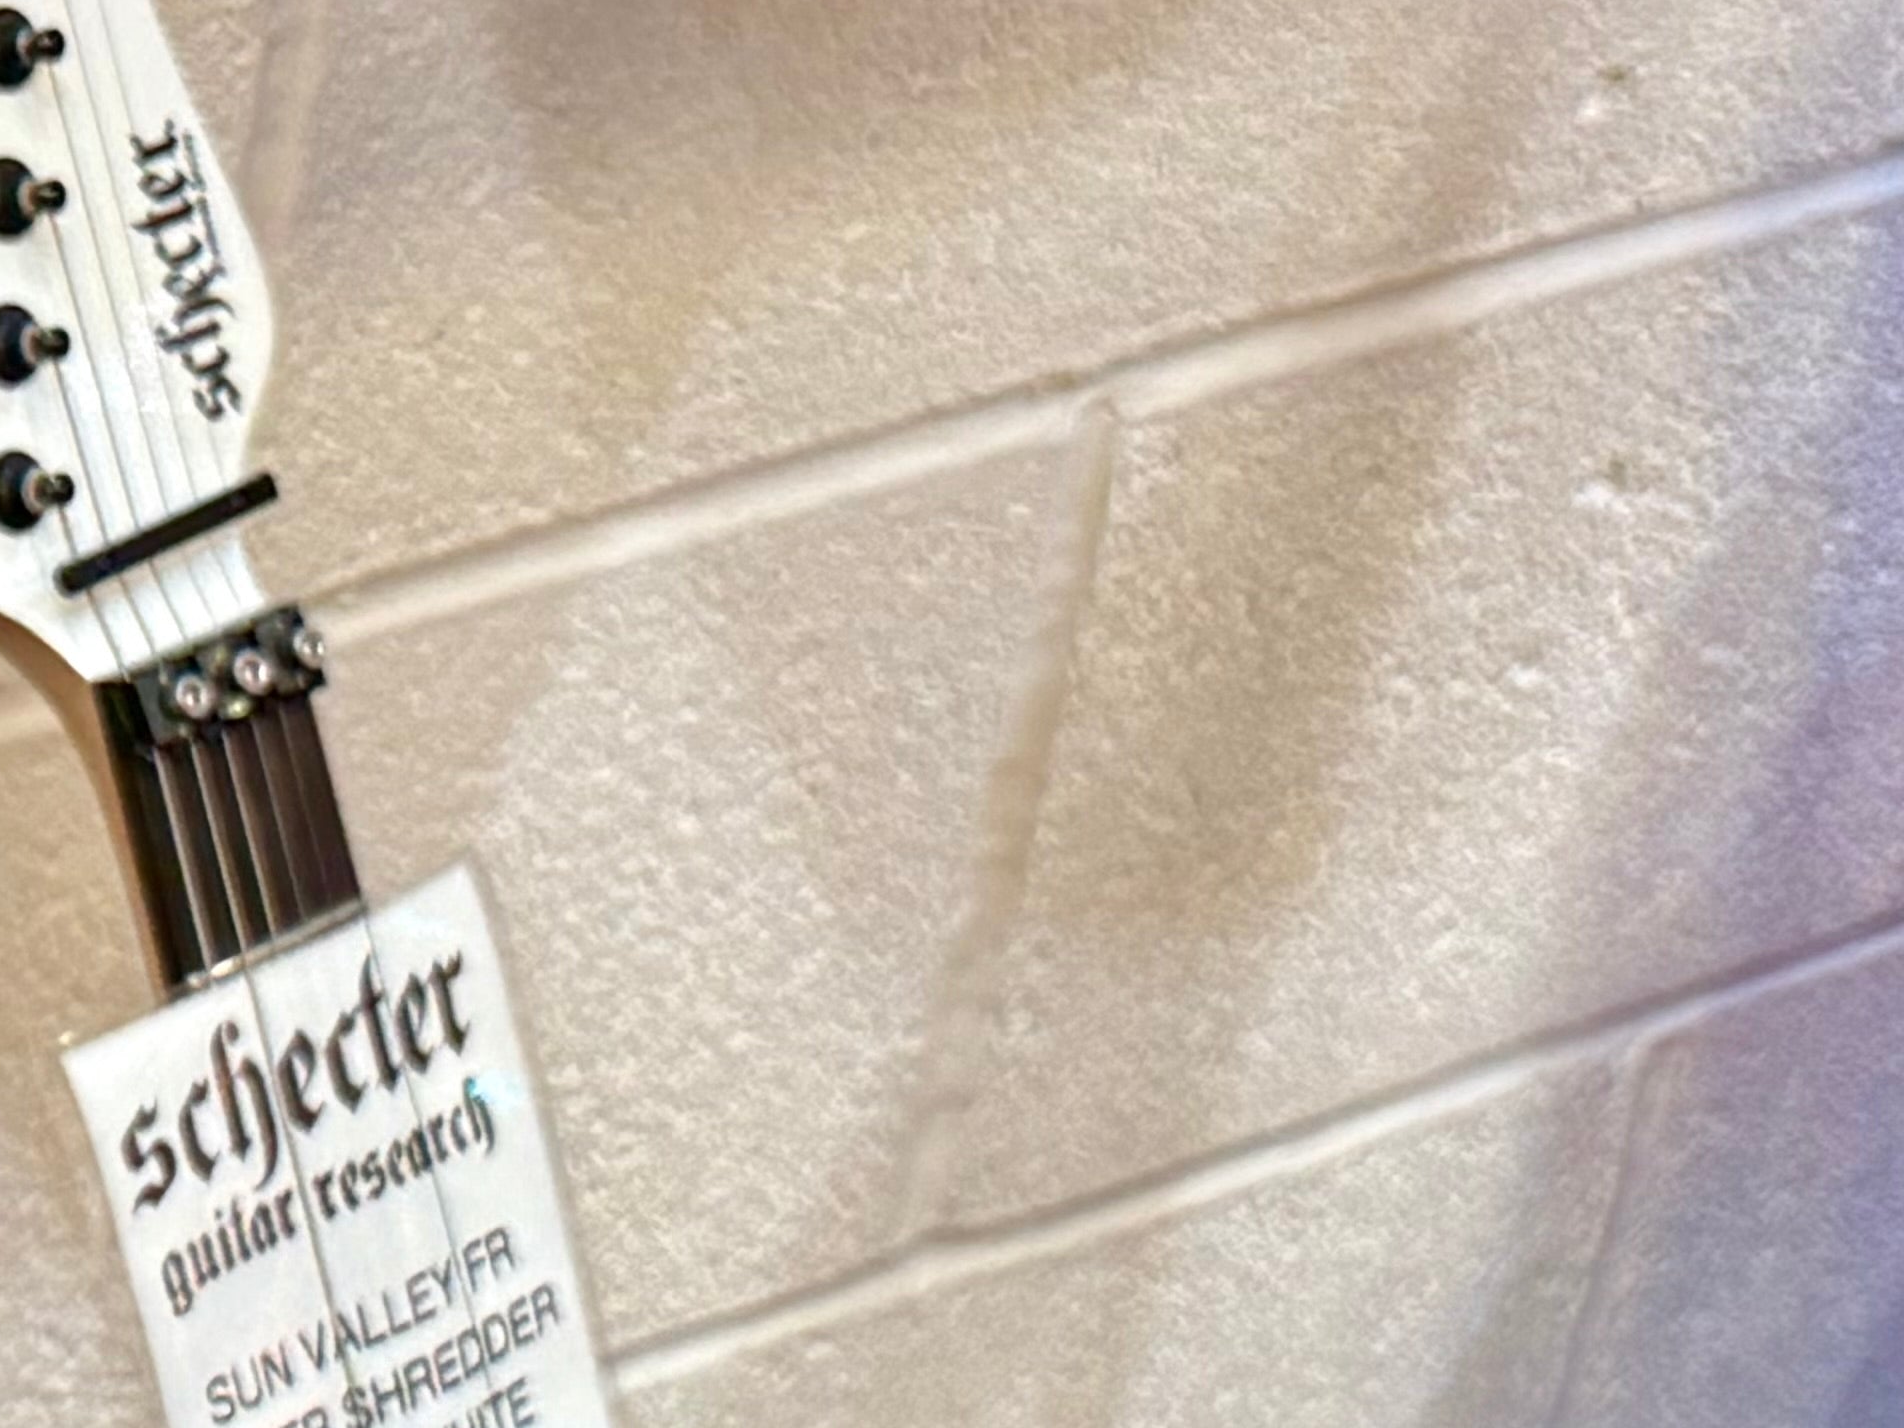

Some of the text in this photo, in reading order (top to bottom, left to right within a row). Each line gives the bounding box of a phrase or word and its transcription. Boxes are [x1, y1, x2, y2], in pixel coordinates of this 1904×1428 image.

[161, 1076, 495, 1317] guitar research
[206, 1227, 517, 1425] SUN VALLEY FR
